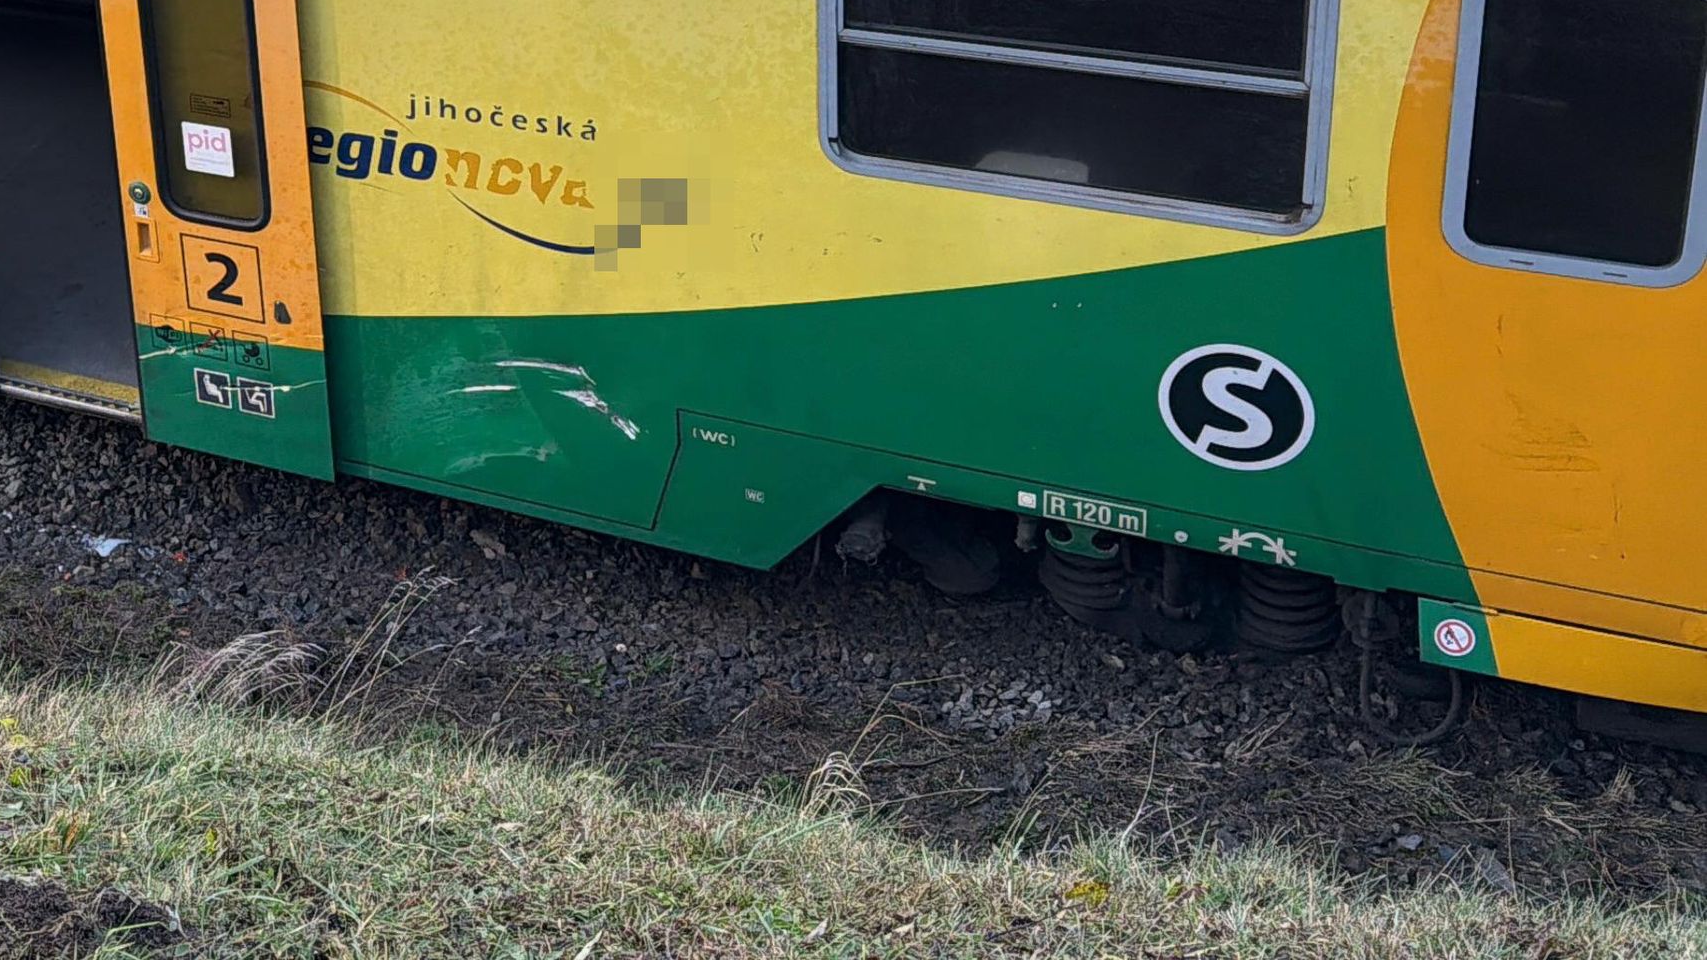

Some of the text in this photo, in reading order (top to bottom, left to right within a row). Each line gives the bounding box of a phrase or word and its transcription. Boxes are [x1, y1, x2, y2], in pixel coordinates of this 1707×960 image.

[405, 93, 597, 142] jihočeská
[187, 129, 227, 153] pid
[305, 124, 595, 210] egionova
[204, 251, 244, 306] 2
[746, 489, 764, 503] WC
[1050, 495, 1140, 532] R 120 m
